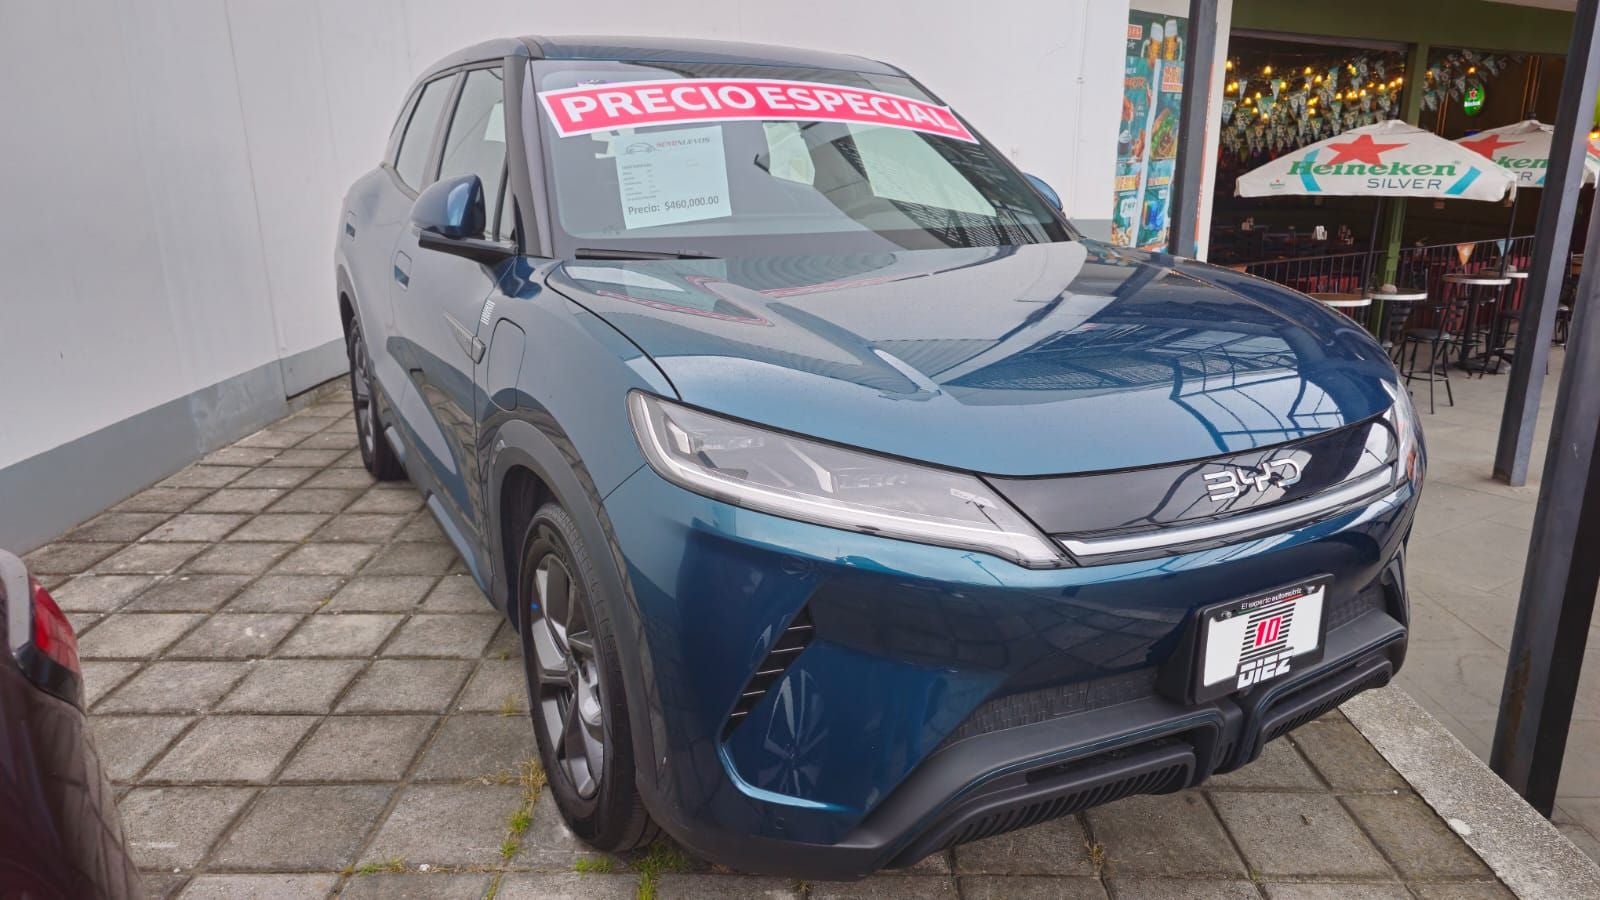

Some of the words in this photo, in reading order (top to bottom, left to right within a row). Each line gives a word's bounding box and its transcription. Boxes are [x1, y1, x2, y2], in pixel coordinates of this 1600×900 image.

[561, 86, 756, 123] PRECIO
[757, 87, 959, 131] ESPECIAL
[1286, 160, 1456, 176] Heineken
[1367, 178, 1442, 190] SILVER
[628, 203, 661, 215] Precio:
[664, 195, 720, 210] $460,000.00
[1203, 459, 1302, 501] BYD
[1254, 615, 1282, 647] 10
[1237, 651, 1294, 689] DIEZ
